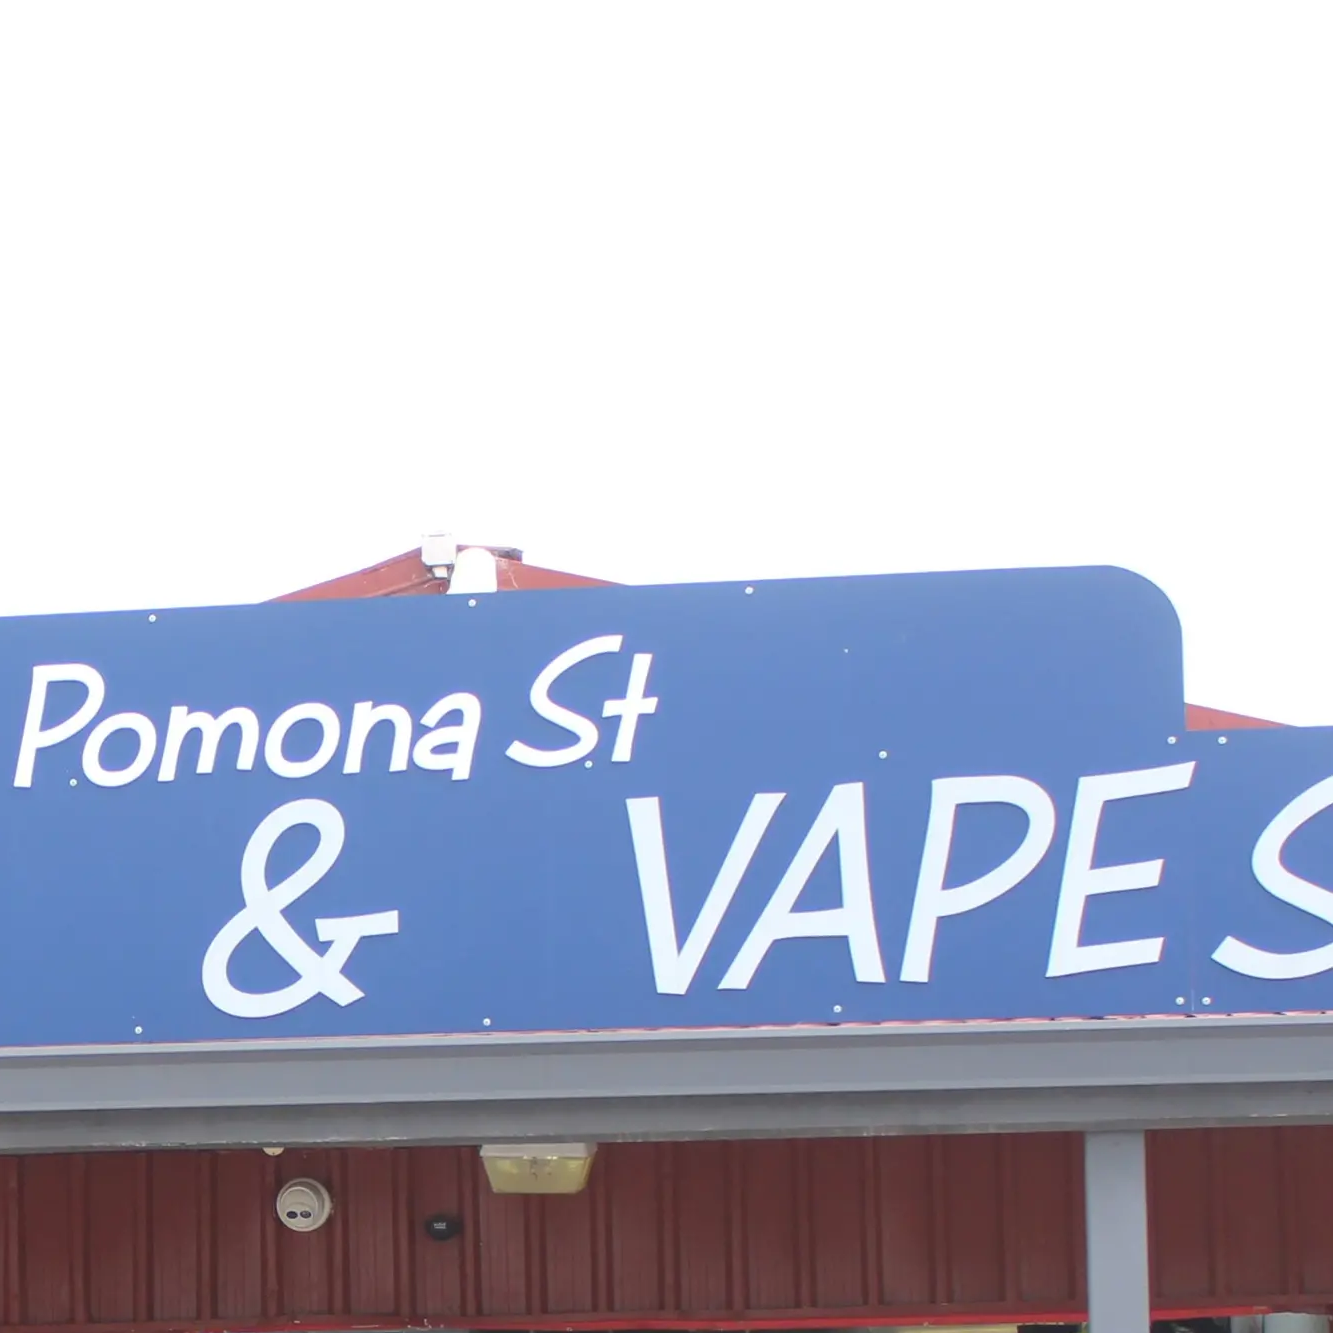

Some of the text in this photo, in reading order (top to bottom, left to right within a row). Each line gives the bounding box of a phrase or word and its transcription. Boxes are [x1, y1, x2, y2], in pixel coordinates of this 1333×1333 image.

[14, 635, 658, 787] Pomona St
[203, 799, 398, 1017] &
[626, 761, 1333, 994] VAPES
